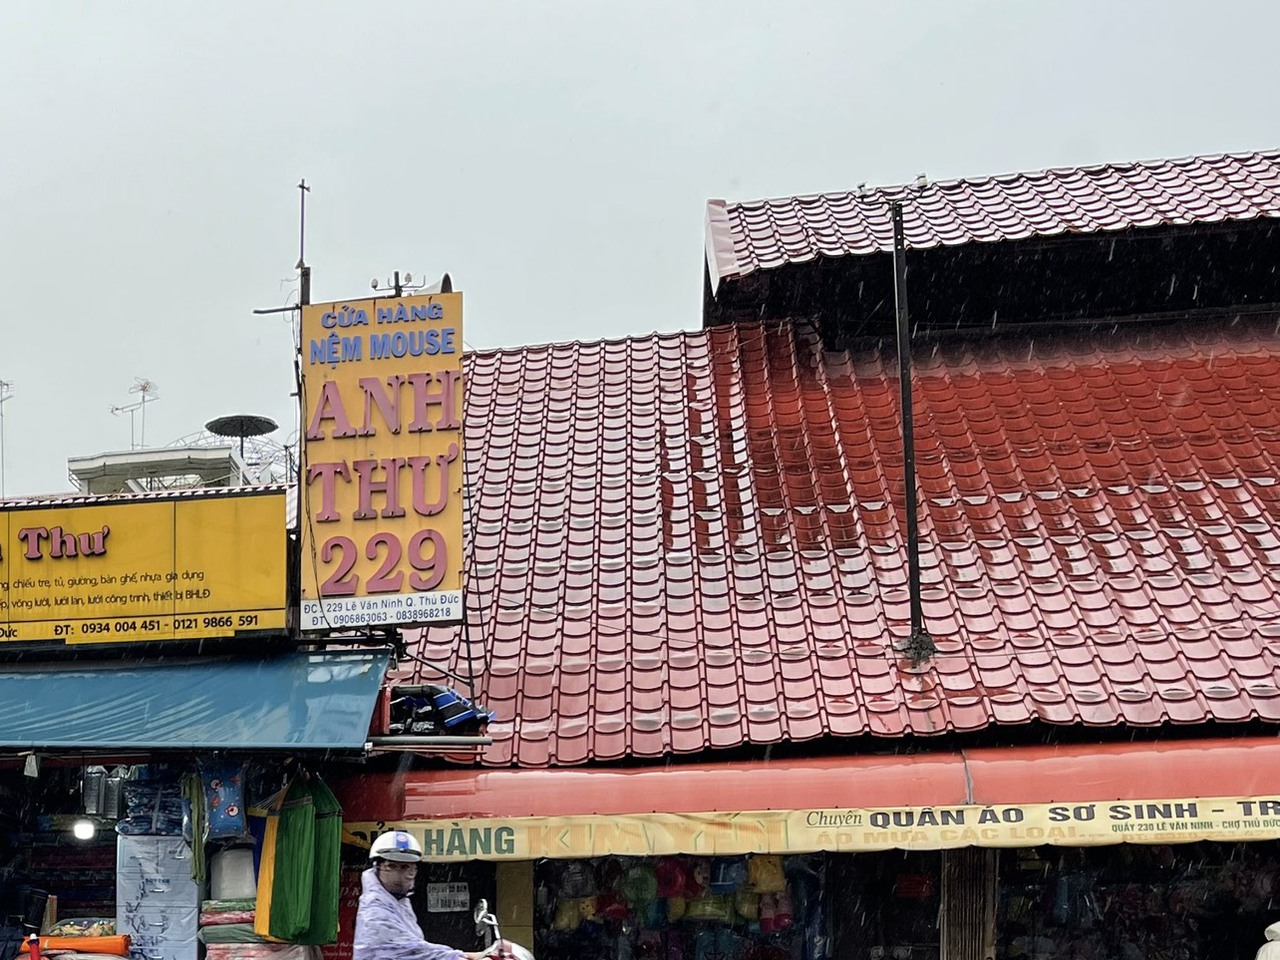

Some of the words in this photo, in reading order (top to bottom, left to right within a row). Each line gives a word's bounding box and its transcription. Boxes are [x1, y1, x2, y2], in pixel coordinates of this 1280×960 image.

[321, 303, 368, 329] CỬA
[376, 301, 443, 324] HÀNG
[310, 331, 362, 369] NỆM
[370, 328, 456, 360] MOUSE
[306, 369, 461, 442] ANH
[306, 442, 459, 523] THƯ
[18, 525, 110, 560] Thư
[321, 528, 448, 596] 229
[101, 575, 117, 584] bàn
[165, 572, 178, 583] gia
[182, 570, 204, 581] dụng
[185, 588, 211, 600] BHLĐ
[326, 603, 342, 613] 229
[381, 598, 403, 609] Ninh
[405, 597, 417, 608] Q.
[420, 595, 437, 606] Thủ
[440, 593, 460, 605] Đức
[54, 624, 74, 635] ĐT:
[81, 622, 110, 634] 0934
[115, 621, 137, 632] 004
[141, 619, 160, 631] 451
[173, 618, 198, 629] 0121
[203, 616, 233, 628] 9866
[238, 614, 258, 626] 591
[333, 613, 388, 625] 0906863063
[396, 608, 451, 621] 0838968218
[807, 810, 863, 829] Chuyên
[978, 805, 1024, 824] ÁO
[1048, 804, 1096, 822] SƠ
[1109, 803, 1198, 820] SINH
[1138, 822, 1154, 831] 230
[1191, 820, 1213, 830] NINH
[424, 822, 515, 856] HÀNG
[863, 829, 929, 844] MƯA
